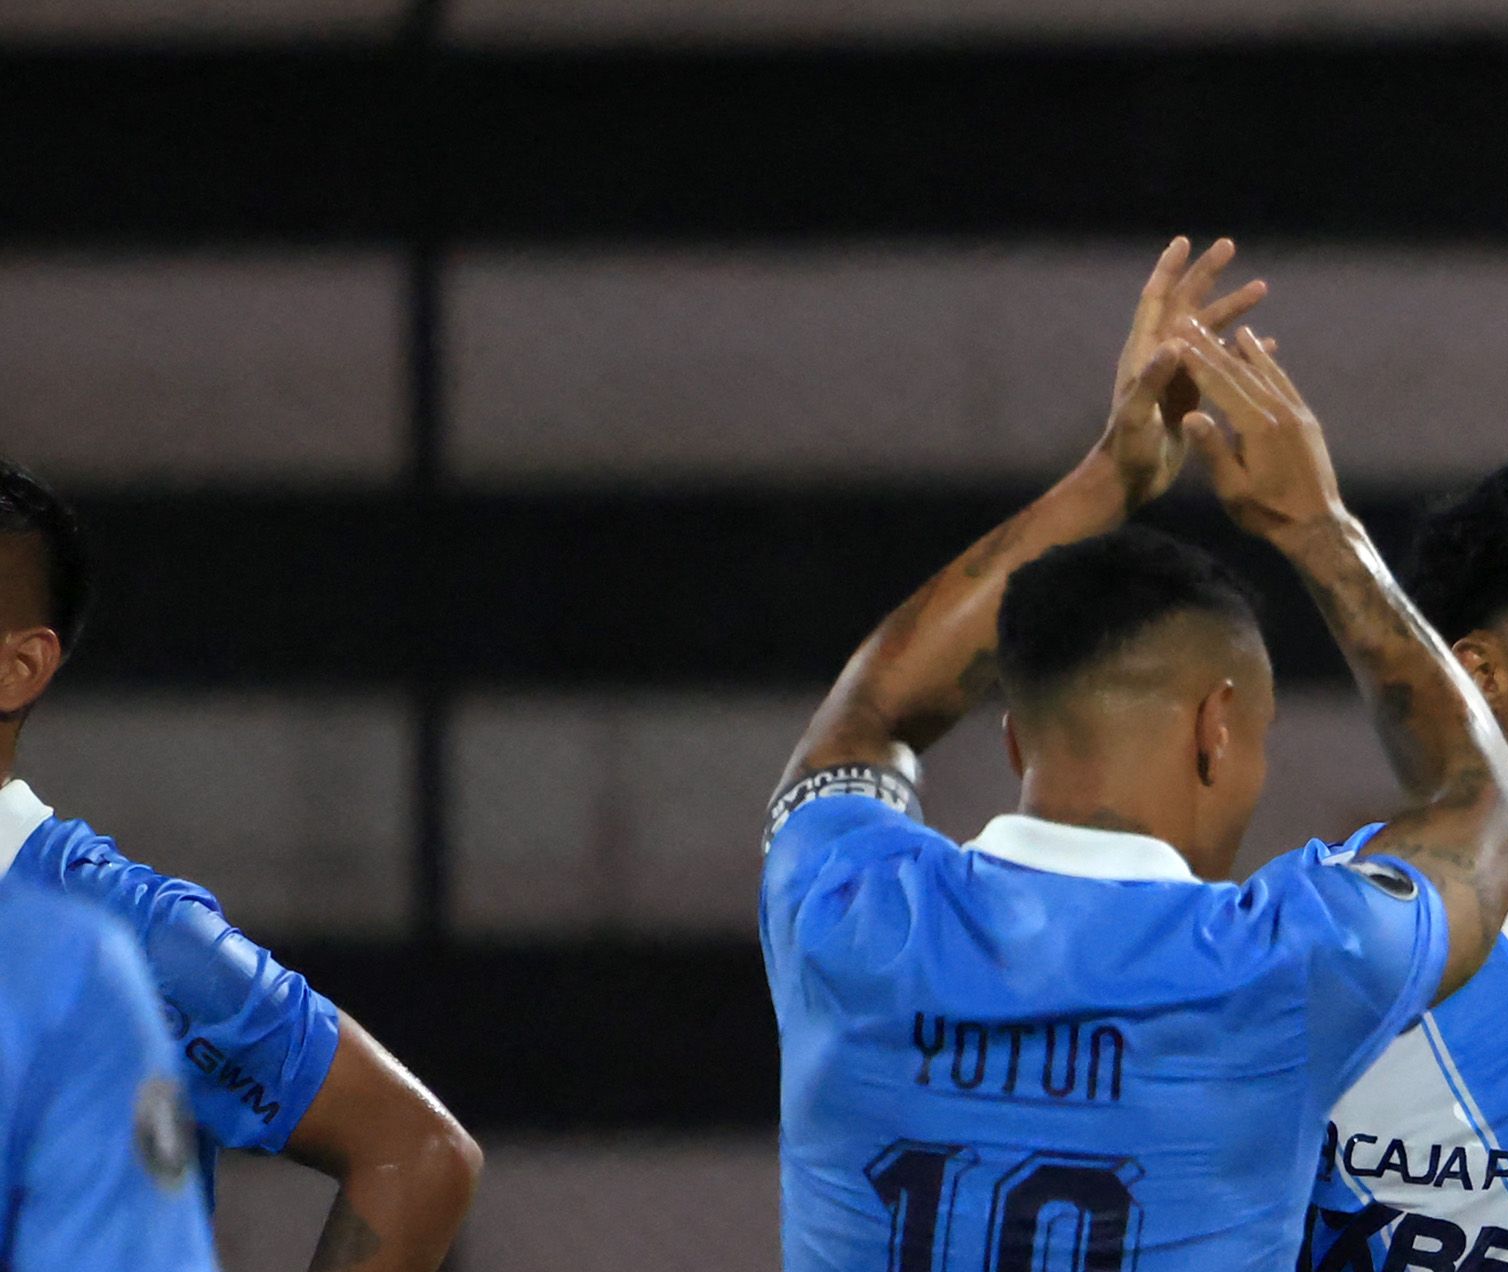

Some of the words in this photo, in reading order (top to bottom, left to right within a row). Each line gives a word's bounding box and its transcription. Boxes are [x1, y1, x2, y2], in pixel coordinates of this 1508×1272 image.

[185, 1037, 281, 1125] GWM
[913, 1010, 1124, 1101] YOTUN
[1344, 1133, 1474, 1191] CAJA
